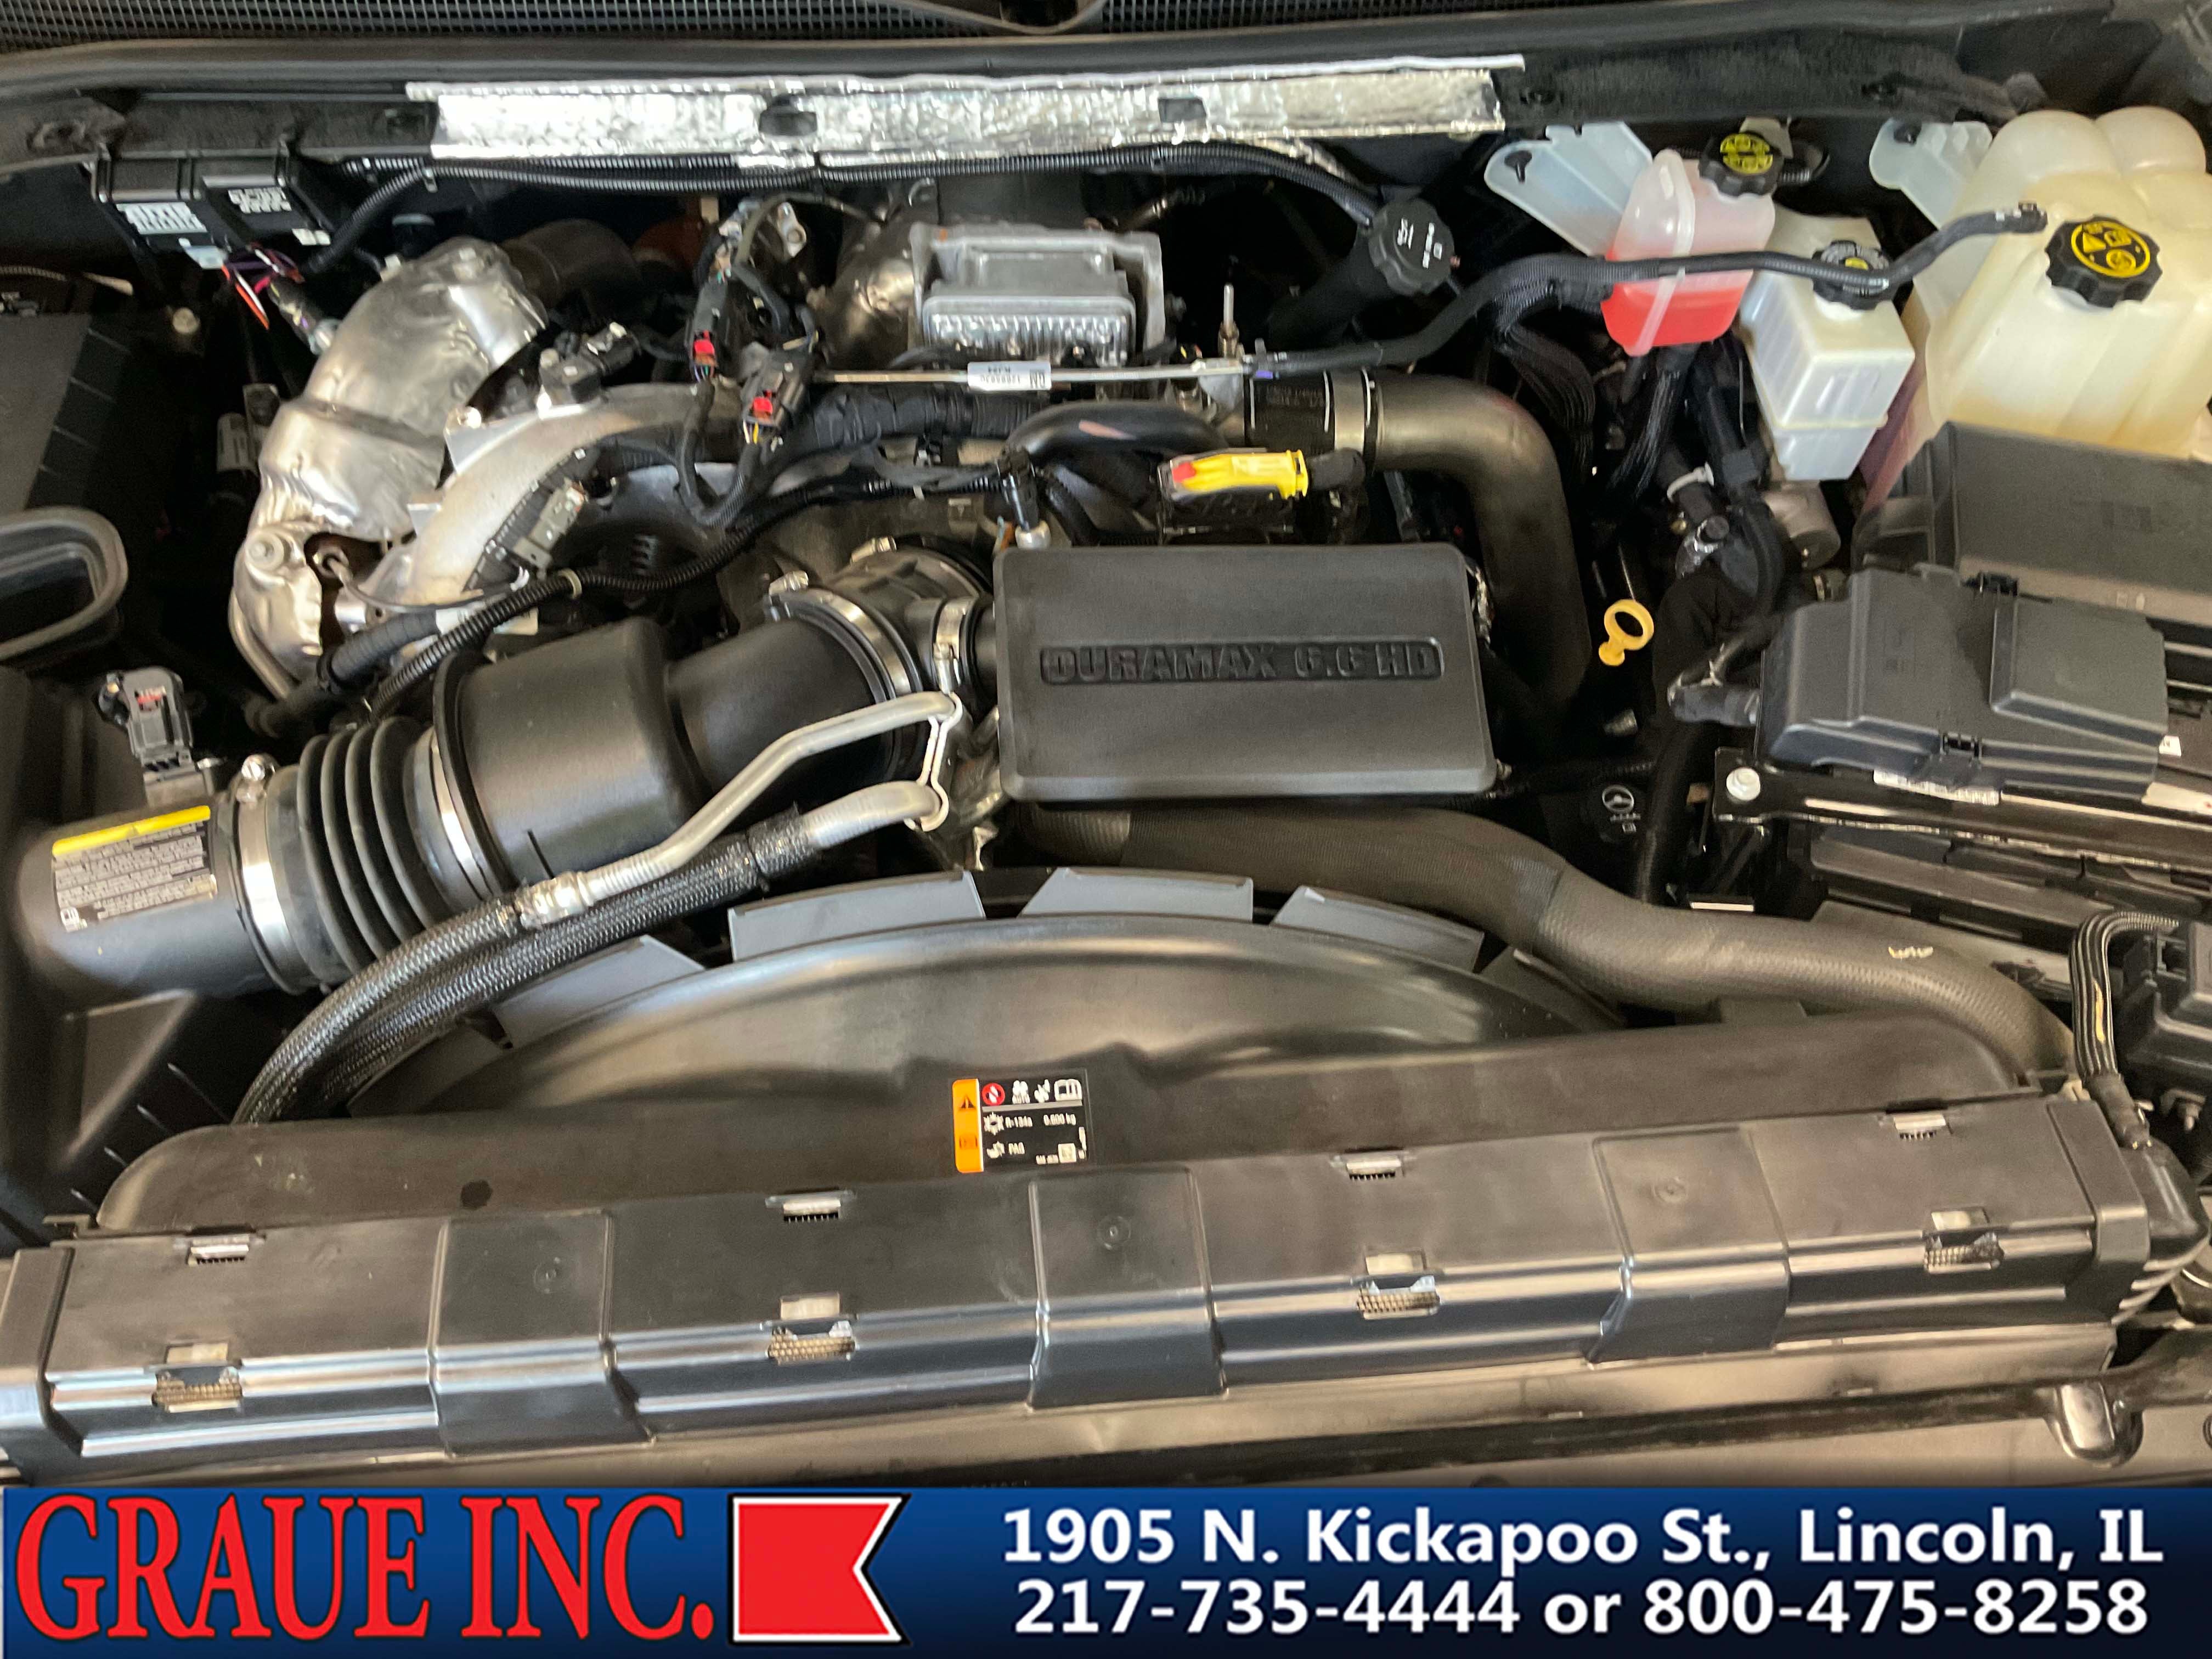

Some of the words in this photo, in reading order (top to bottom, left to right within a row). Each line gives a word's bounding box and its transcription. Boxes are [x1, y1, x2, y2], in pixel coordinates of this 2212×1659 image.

[1042, 644, 1278, 682] DURAMAX
[1294, 644, 1365, 678] 6.6
[1375, 642, 1440, 678] HD
